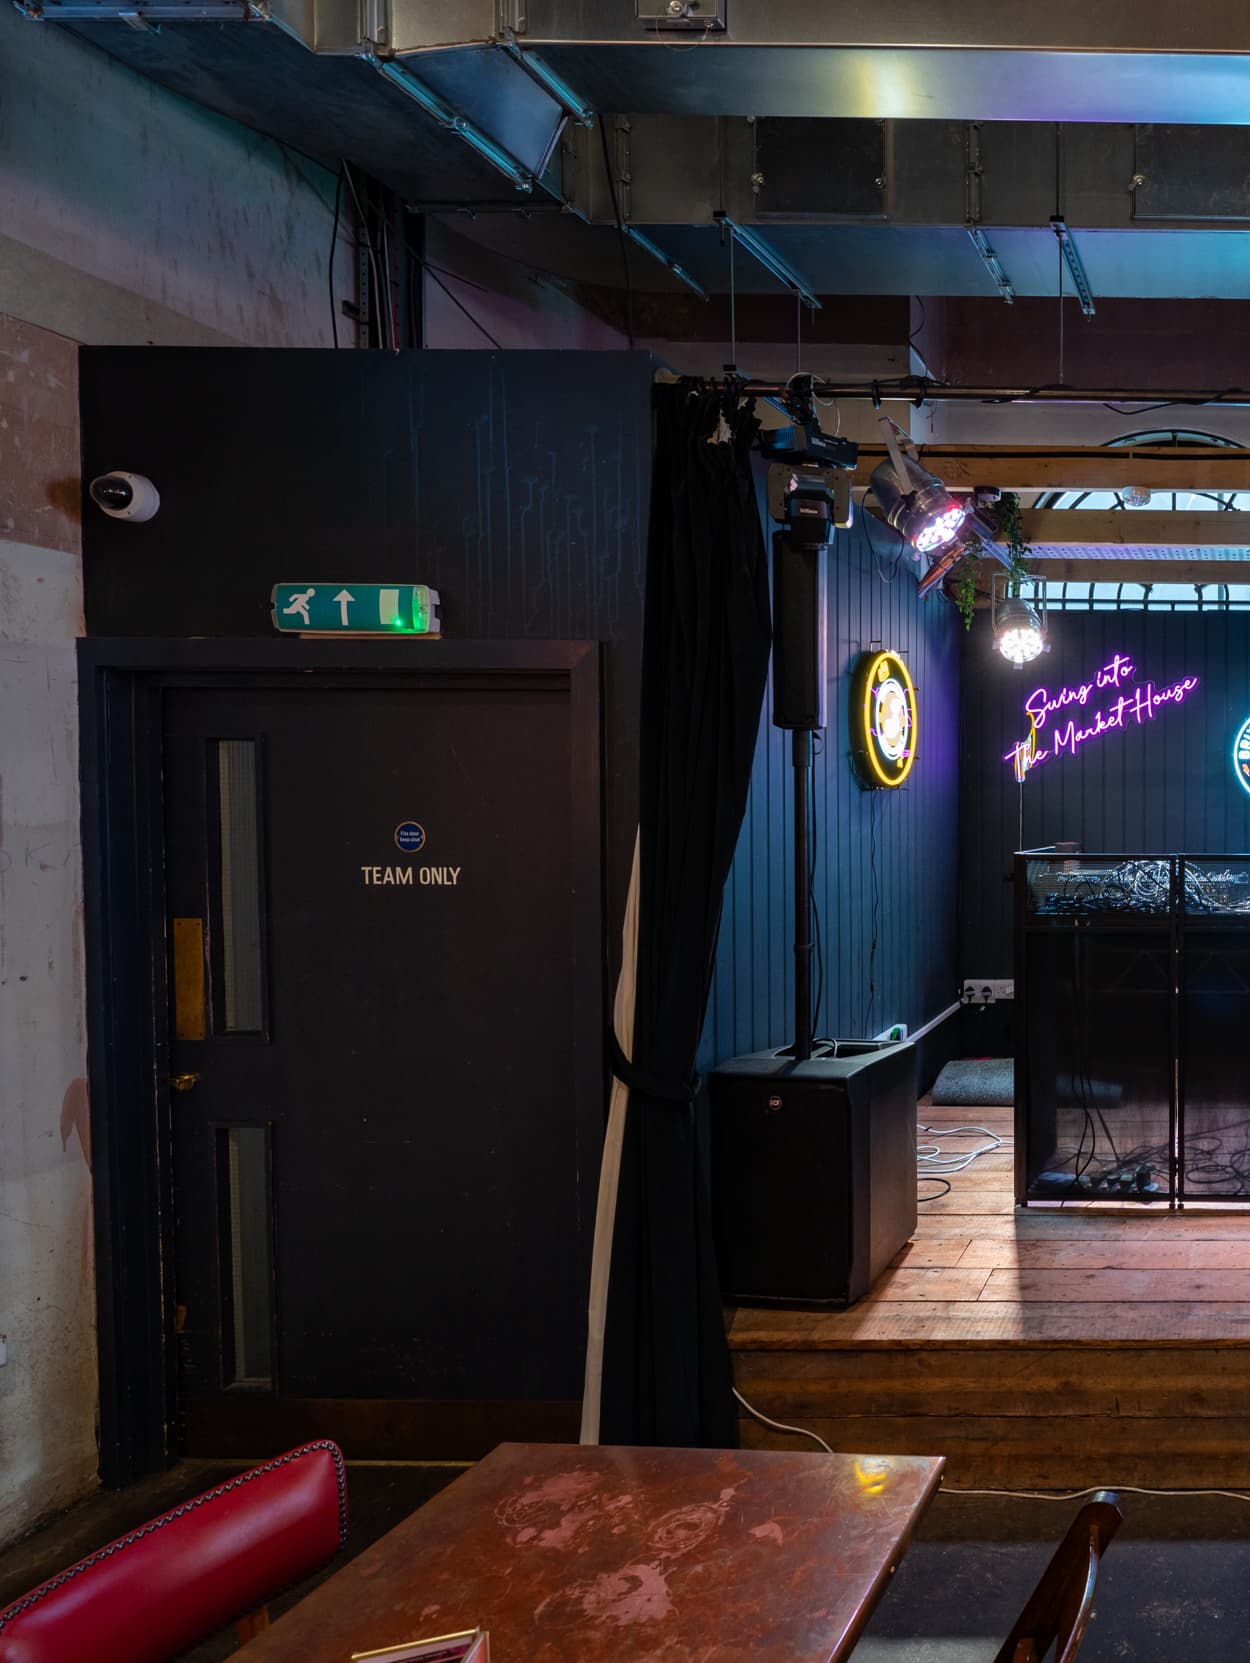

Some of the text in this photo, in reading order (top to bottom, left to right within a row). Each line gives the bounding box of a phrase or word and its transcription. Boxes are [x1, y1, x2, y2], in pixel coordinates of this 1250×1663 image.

[1025, 654, 1133, 728] Swing into
[1054, 696, 1134, 755] Market
[1129, 678, 1198, 723] House
[361, 866, 461, 885] TEAM ONLY
